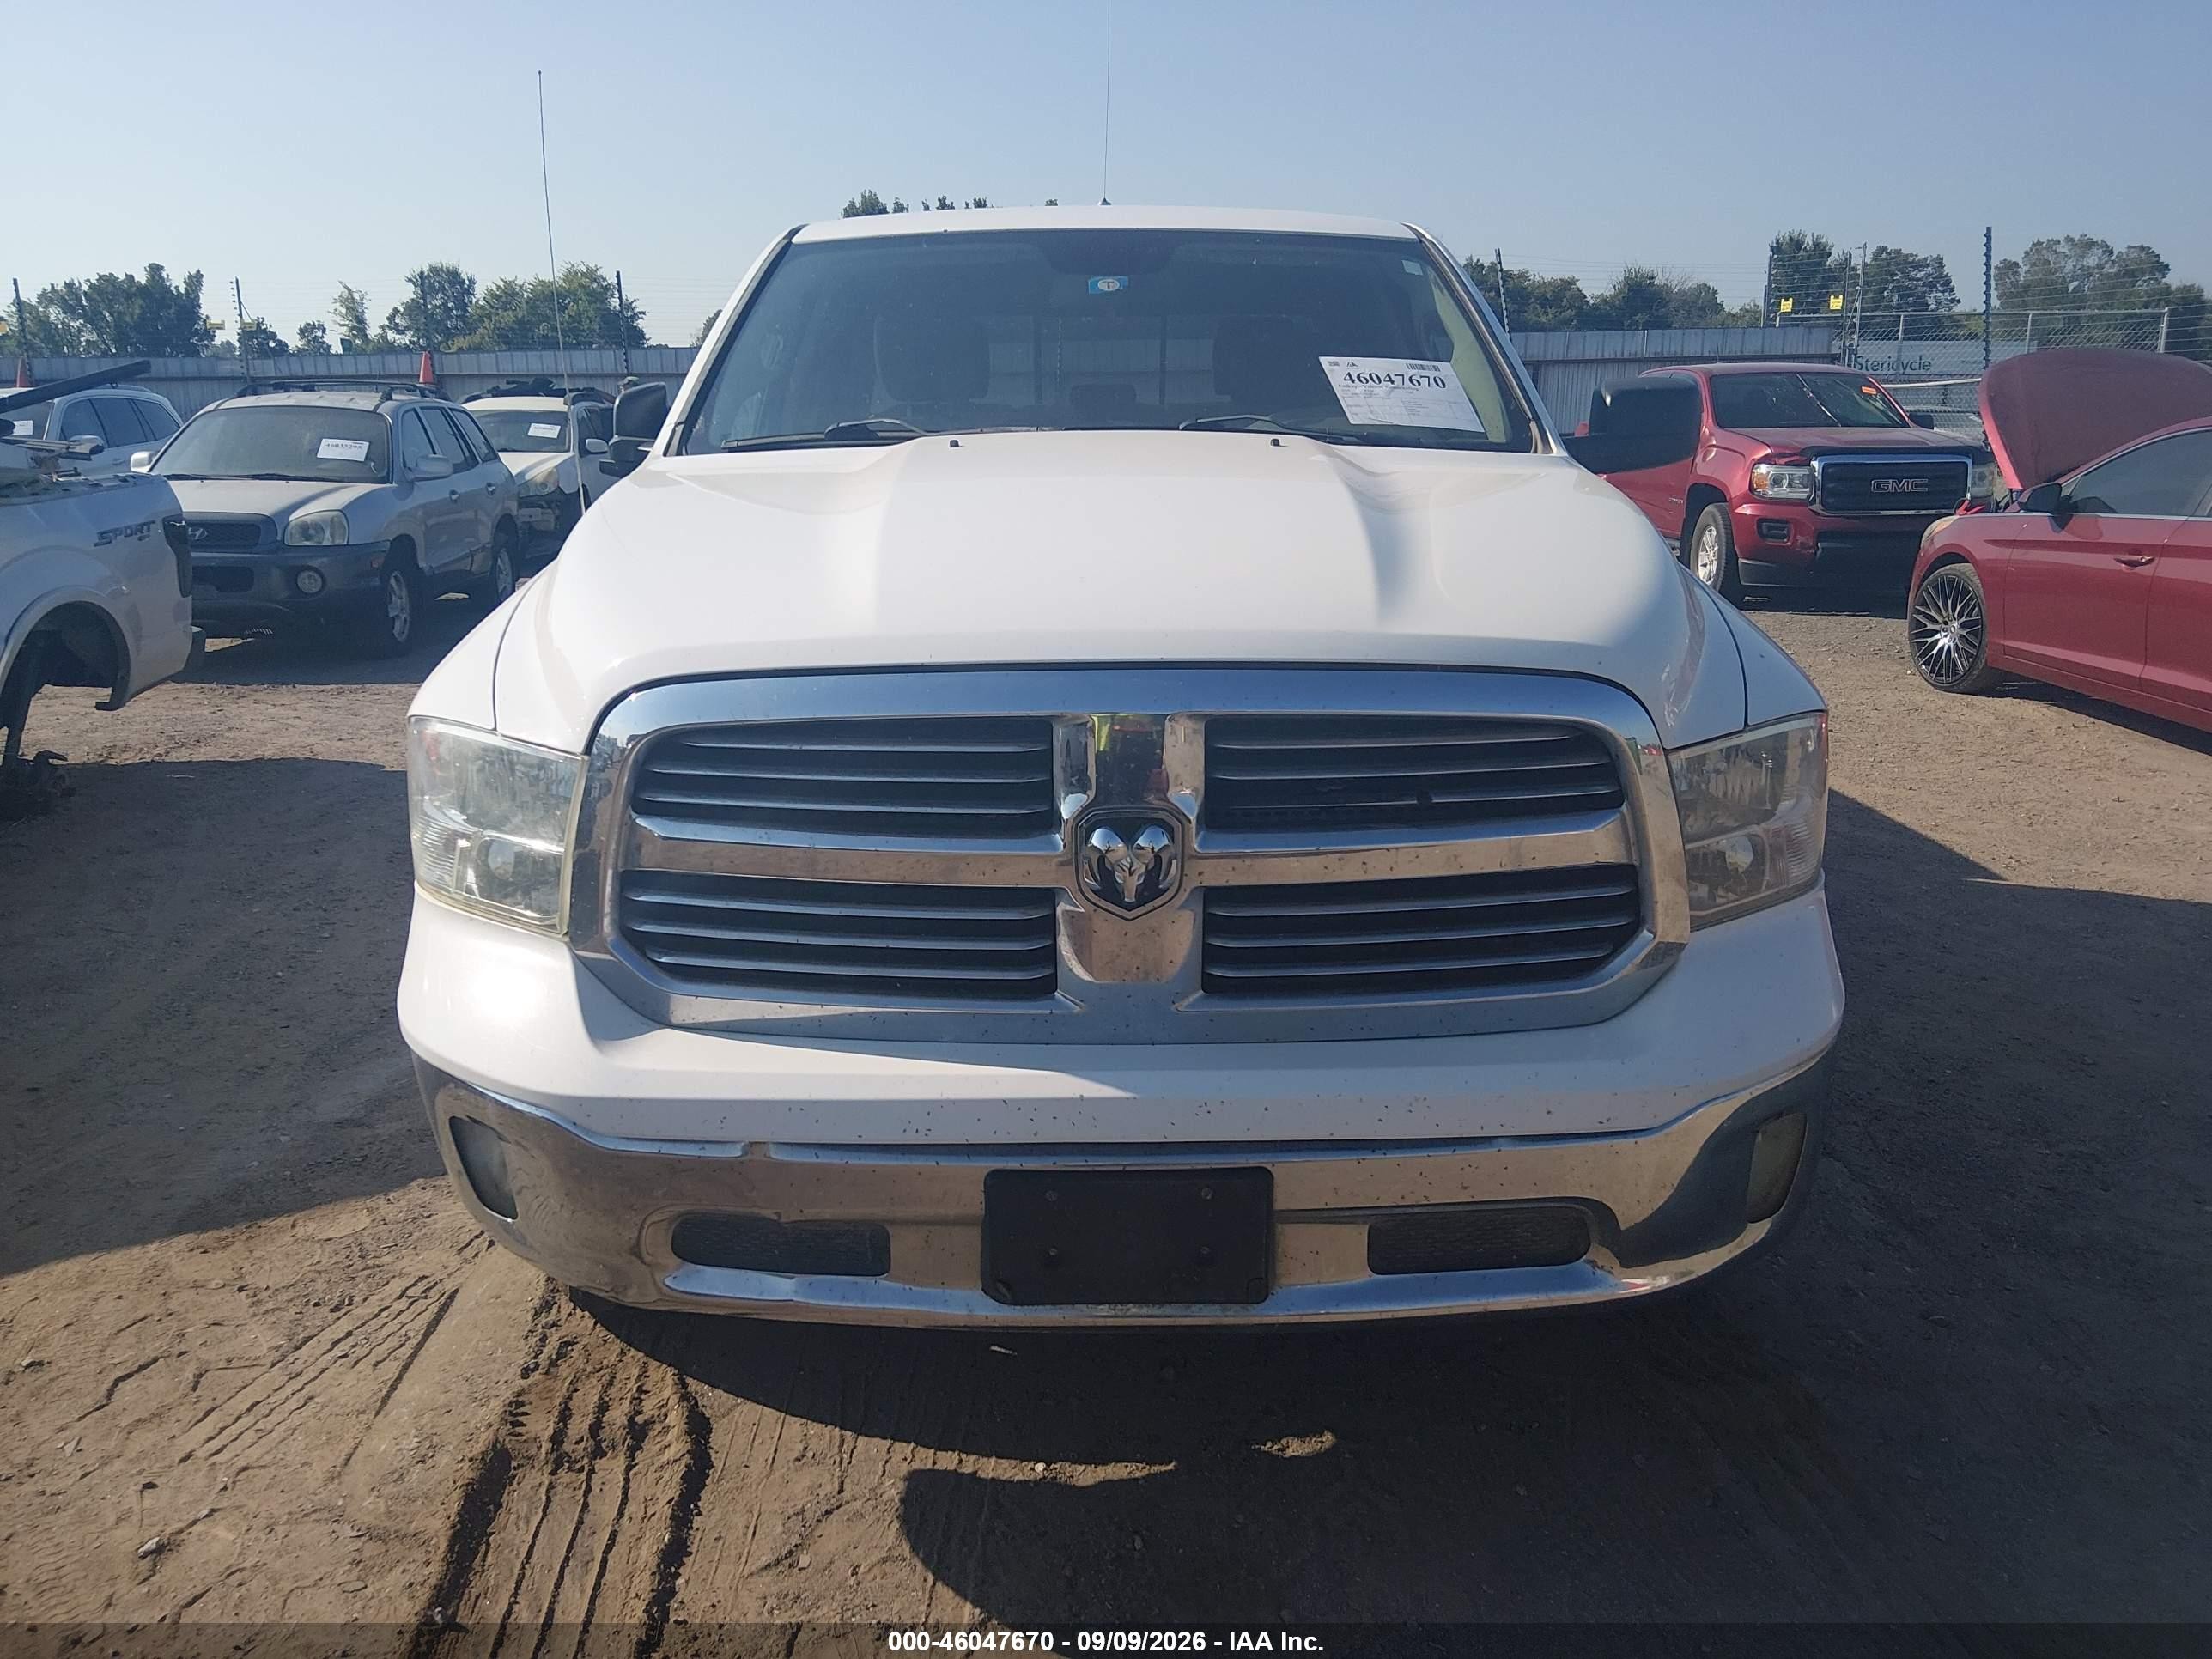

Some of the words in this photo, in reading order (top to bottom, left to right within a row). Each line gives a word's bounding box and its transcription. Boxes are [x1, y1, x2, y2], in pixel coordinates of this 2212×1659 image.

[1855, 355, 1931, 374] Stericycle
[1343, 371, 1447, 389] 46047670
[1871, 478, 1929, 493] GMC
[93, 520, 156, 547] SPORT
